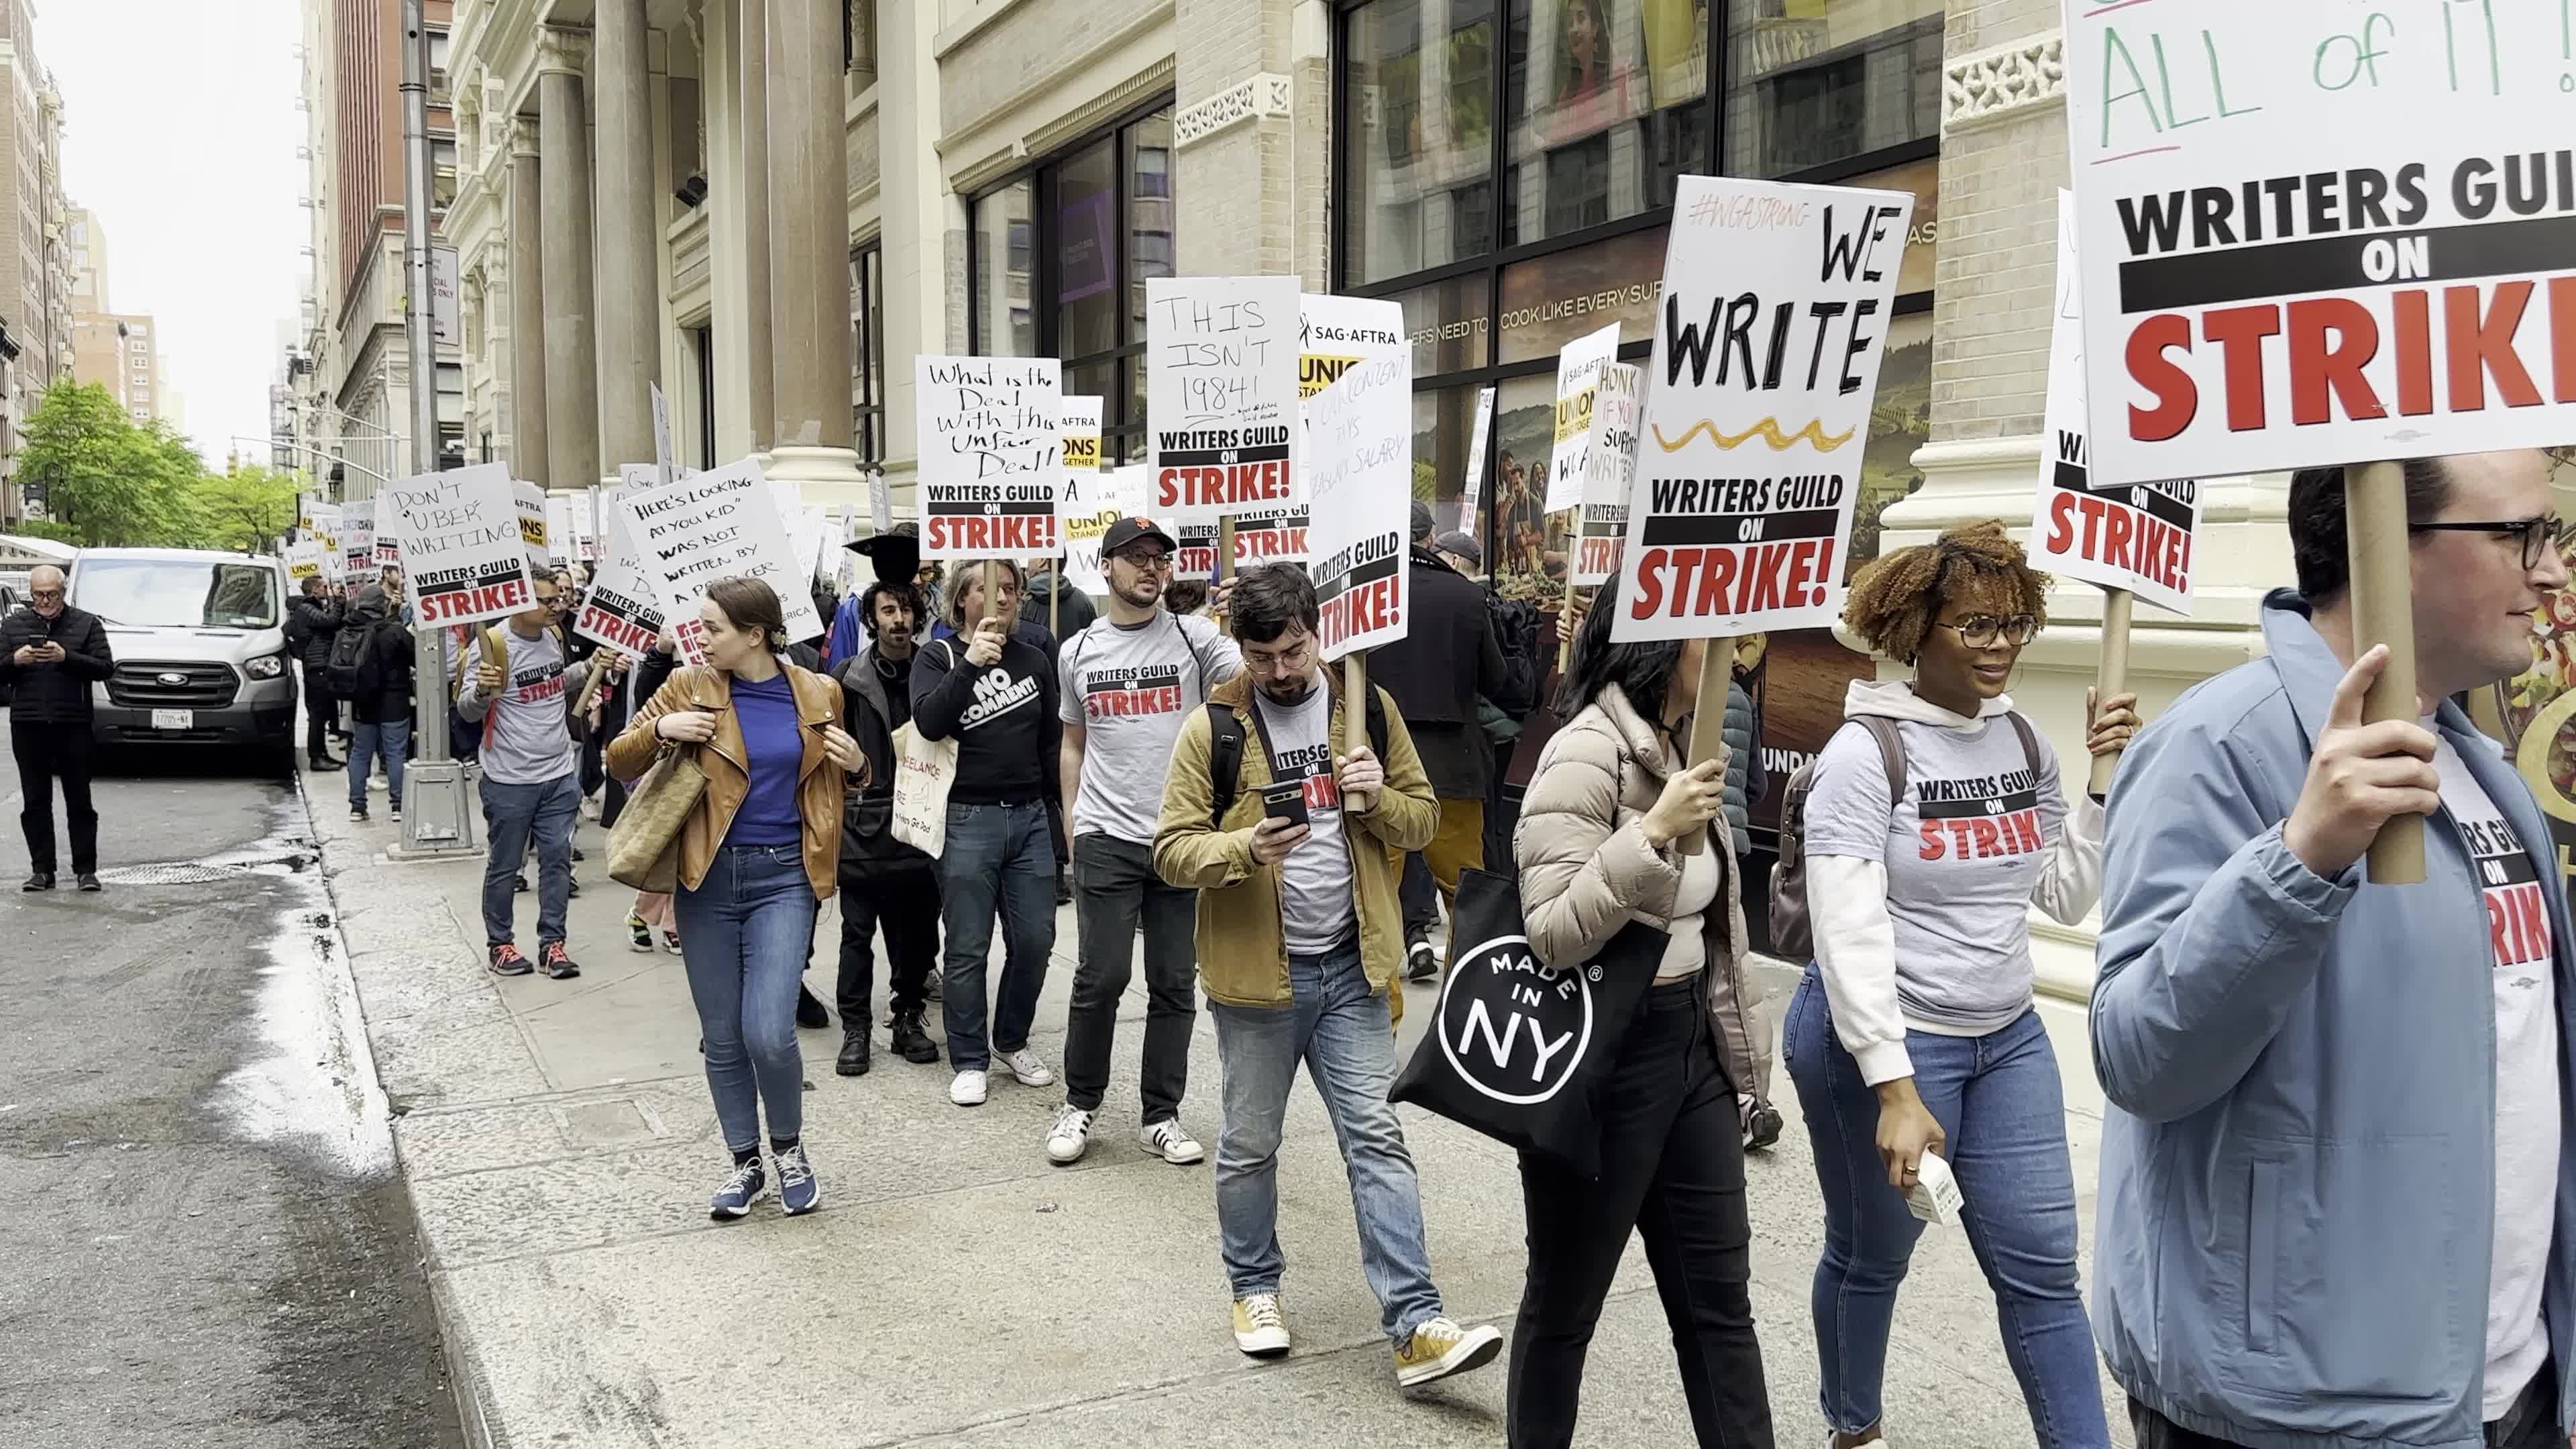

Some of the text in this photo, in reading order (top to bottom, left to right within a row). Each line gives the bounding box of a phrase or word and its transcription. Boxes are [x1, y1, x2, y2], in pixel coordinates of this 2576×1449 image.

[2100, 27, 2263, 149] ALL
[2115, 149, 2576, 256] WRITERS GUI
[1821, 204, 1902, 282] WE
[2361, 236, 2430, 283] ON
[1155, 296, 1267, 333] THIS
[1436, 321, 1470, 341] NEED
[1471, 316, 1489, 333] TO
[1501, 306, 1539, 329] COOK
[1542, 299, 1574, 321] LIKE
[1576, 287, 1628, 316] EVERY
[1166, 334, 1271, 369] ISN'T
[1665, 292, 1878, 397] WRITE
[929, 363, 1052, 387] What is the
[1600, 364, 1638, 397] HONK
[953, 388, 1020, 411] Deal
[1603, 399, 1615, 423] IF
[1011, 406, 1056, 430] this
[1159, 425, 1289, 451] WRITERS GUILD
[971, 446, 1056, 479] Deal!
[1220, 451, 1238, 464] ON
[392, 480, 462, 513] DON'T
[689, 477, 754, 504] LOOKING
[928, 485, 1001, 501] WRITERS
[1006, 484, 1053, 500] GUILD
[1159, 460, 1290, 507] STRIKE!
[1651, 474, 1843, 514] WRITERS GUILD
[983, 504, 1002, 515] ON
[2131, 485, 2149, 511] ON
[1274, 519, 1288, 529] ON
[1585, 503, 1620, 522] WRITERS
[403, 521, 517, 556] WRITING
[649, 525, 666, 540] AT
[667, 516, 703, 532] YOU
[928, 515, 1056, 549] STRIKE!
[1070, 529, 1099, 539] STAND
[1179, 525, 1218, 537] WRITERS
[1737, 518, 1763, 542] ON
[657, 525, 741, 561] WAS NOT
[2047, 491, 2192, 594] STRIKE!
[414, 557, 520, 586] WRITERS GUILD
[663, 557, 732, 582] WRITTEN
[737, 543, 758, 558] BY
[1312, 531, 1399, 588] WRITERS GUILD
[463, 579, 479, 590] ON
[1341, 572, 1351, 591] ON
[1630, 537, 1835, 621] STRIKE!
[420, 579, 529, 622] STRIKE!
[594, 584, 642, 615] WRITERS
[674, 593, 690, 604] A
[1322, 575, 1400, 650] TRIKE!
[624, 612, 638, 623] ON
[515, 666, 549, 682] WRITERS
[973, 667, 1012, 700] NO
[1087, 664, 1179, 684] WRITERS GUILD
[1124, 680, 1138, 690] ON
[958, 674, 1038, 724] COMMENT!
[1087, 686, 1182, 717] STRIKE!
[1276, 748, 1316, 771] ITERS
[1304, 762, 1319, 776] ON
[1917, 775, 1998, 801] WRITERS
[1985, 799, 2006, 814] ON
[2482, 859, 2510, 885] ON
[1490, 953, 1577, 1001] MADE
[1511, 982, 1543, 1008] IN
[1457, 998, 1574, 1083] NY
